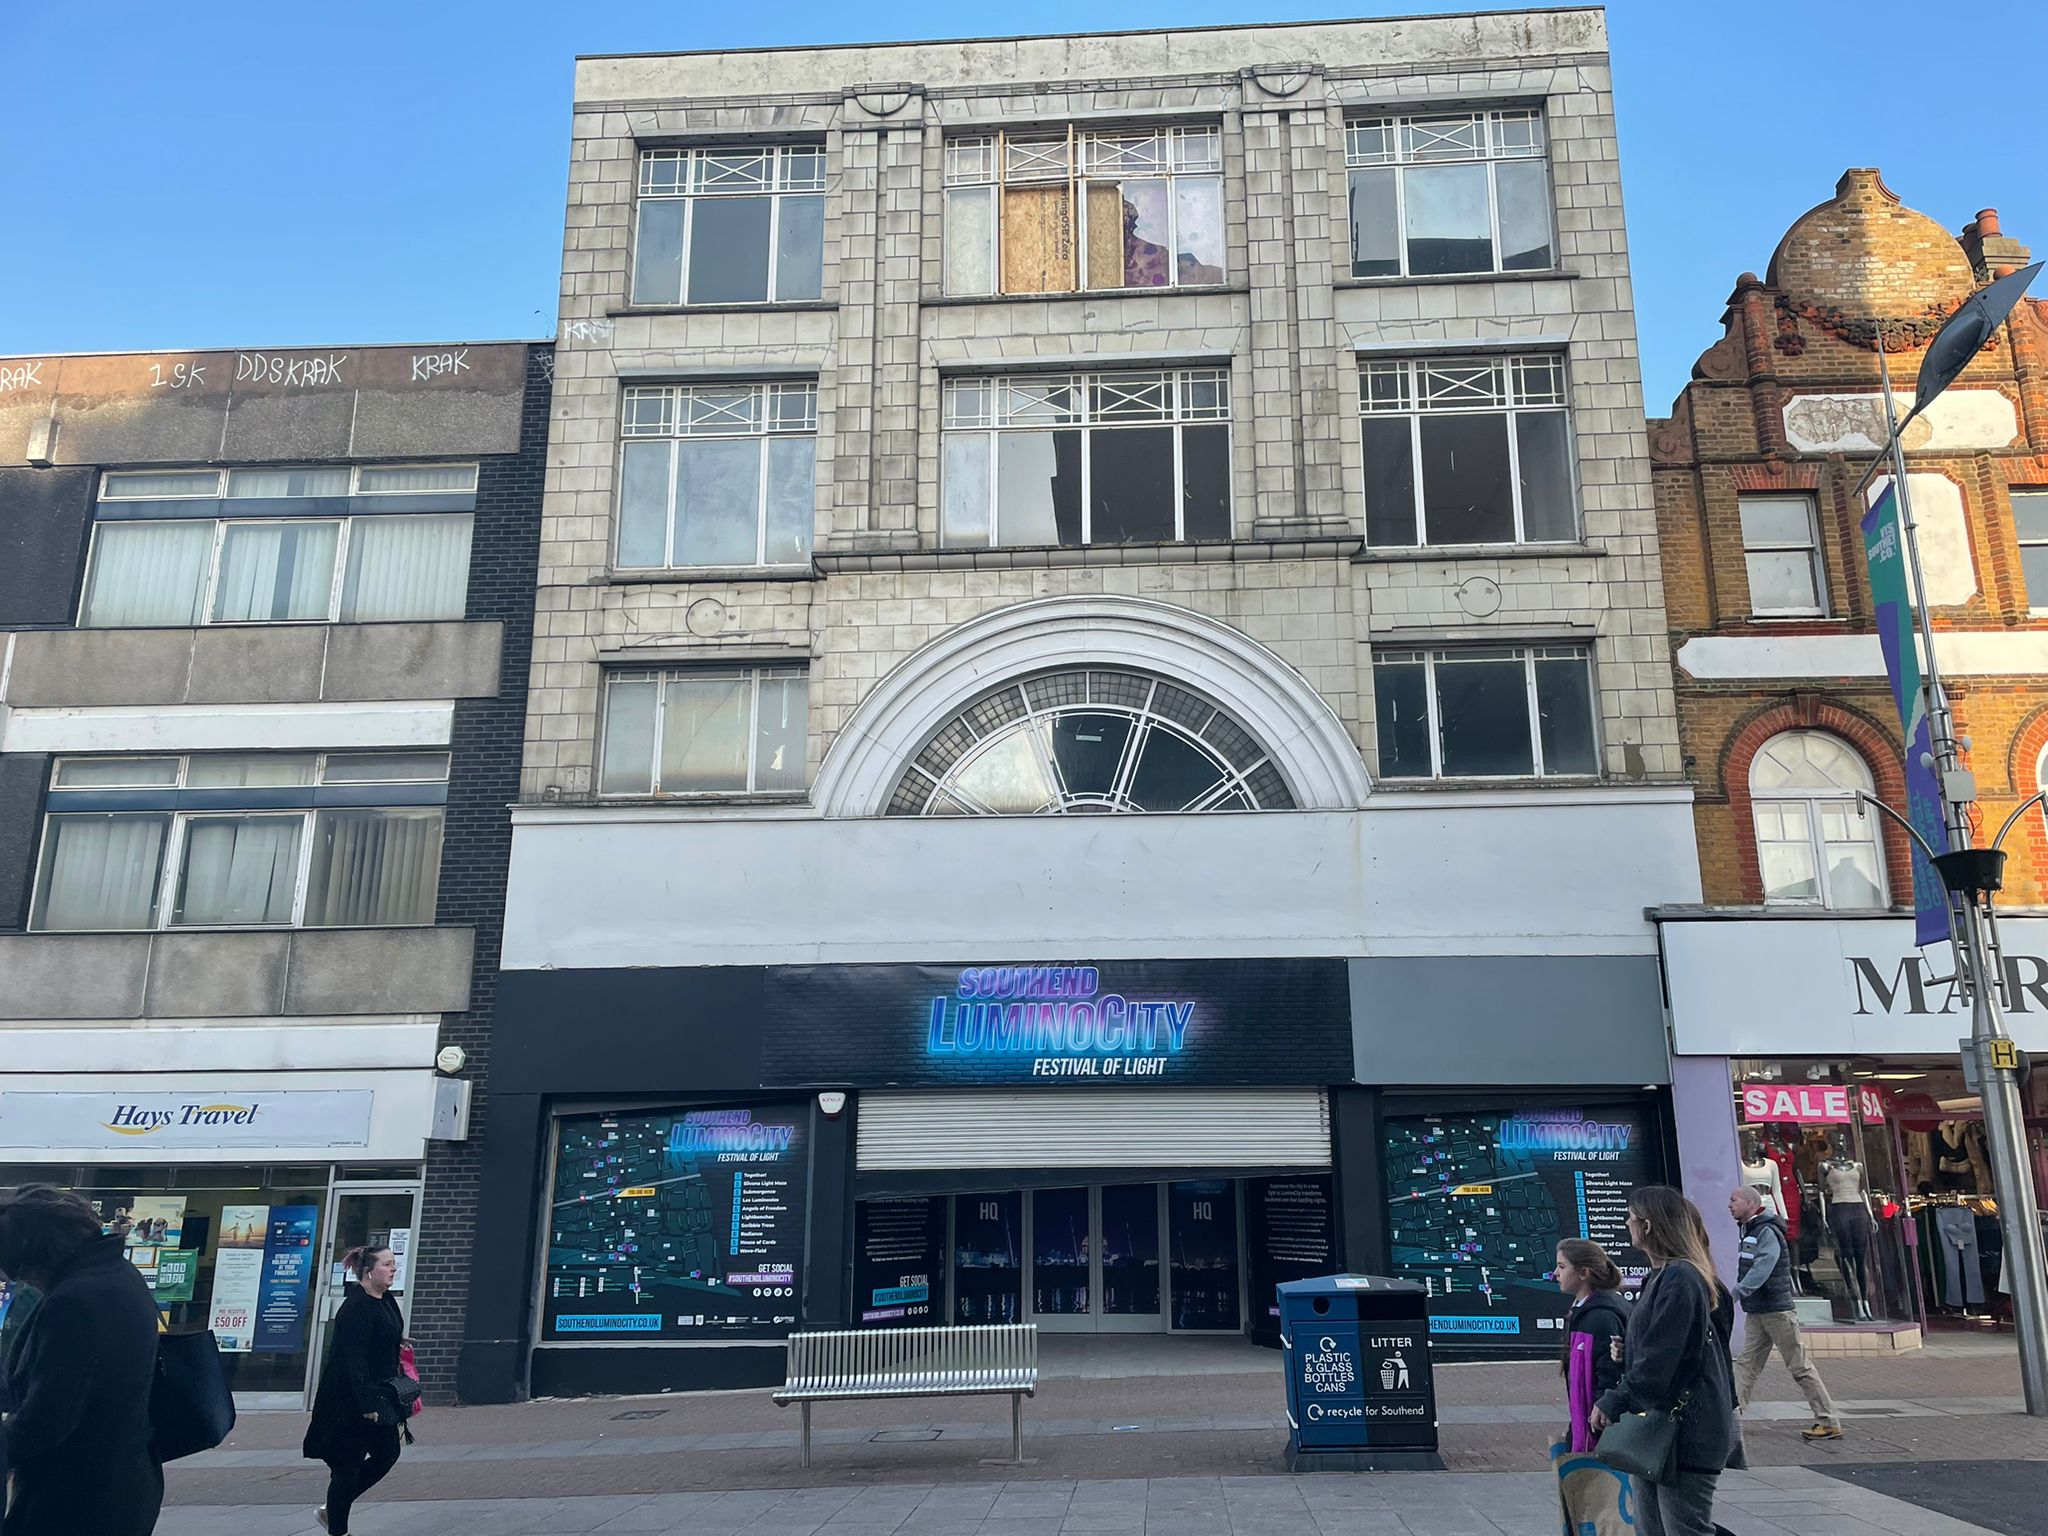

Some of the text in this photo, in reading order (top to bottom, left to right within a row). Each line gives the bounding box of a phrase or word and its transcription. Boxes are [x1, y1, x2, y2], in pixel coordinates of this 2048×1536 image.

[411, 349, 471, 380] KRAK
[958, 967, 1099, 998] SOUTHEND
[1994, 1043, 2014, 1065] H
[1032, 1057, 1167, 1076] FESTIVAL OF LIGHT
[1745, 1090, 1848, 1117] SALE
[110, 1104, 260, 1131] Hays Travel
[685, 1110, 751, 1126] SOUTHEND
[1512, 1106, 1583, 1122] SOUTHEND
[717, 1152, 779, 1162] FESTIVAL OF LIGHT
[1553, 1151, 1620, 1160] FESTIVAL OF LIGHT
[980, 1202, 998, 1220] HQ
[1193, 1202, 1212, 1220] HQ
[758, 1263, 794, 1273] GET SOCIAL
[1619, 1266, 1652, 1276] ET SOCIA
[215, 1316, 248, 1328] £50 OFF
[1428, 1319, 1518, 1331] HENDLUMINOCITY.CO.UK
[1371, 1337, 1413, 1348] LITTER
[1305, 1352, 1351, 1363] PLASTIC
[1305, 1362, 1353, 1373] & GLASS
[1304, 1372, 1355, 1383] BOTTLES
[1315, 1382, 1346, 1393] CANS
[1327, 1405, 1424, 1418] recycle for Southend
